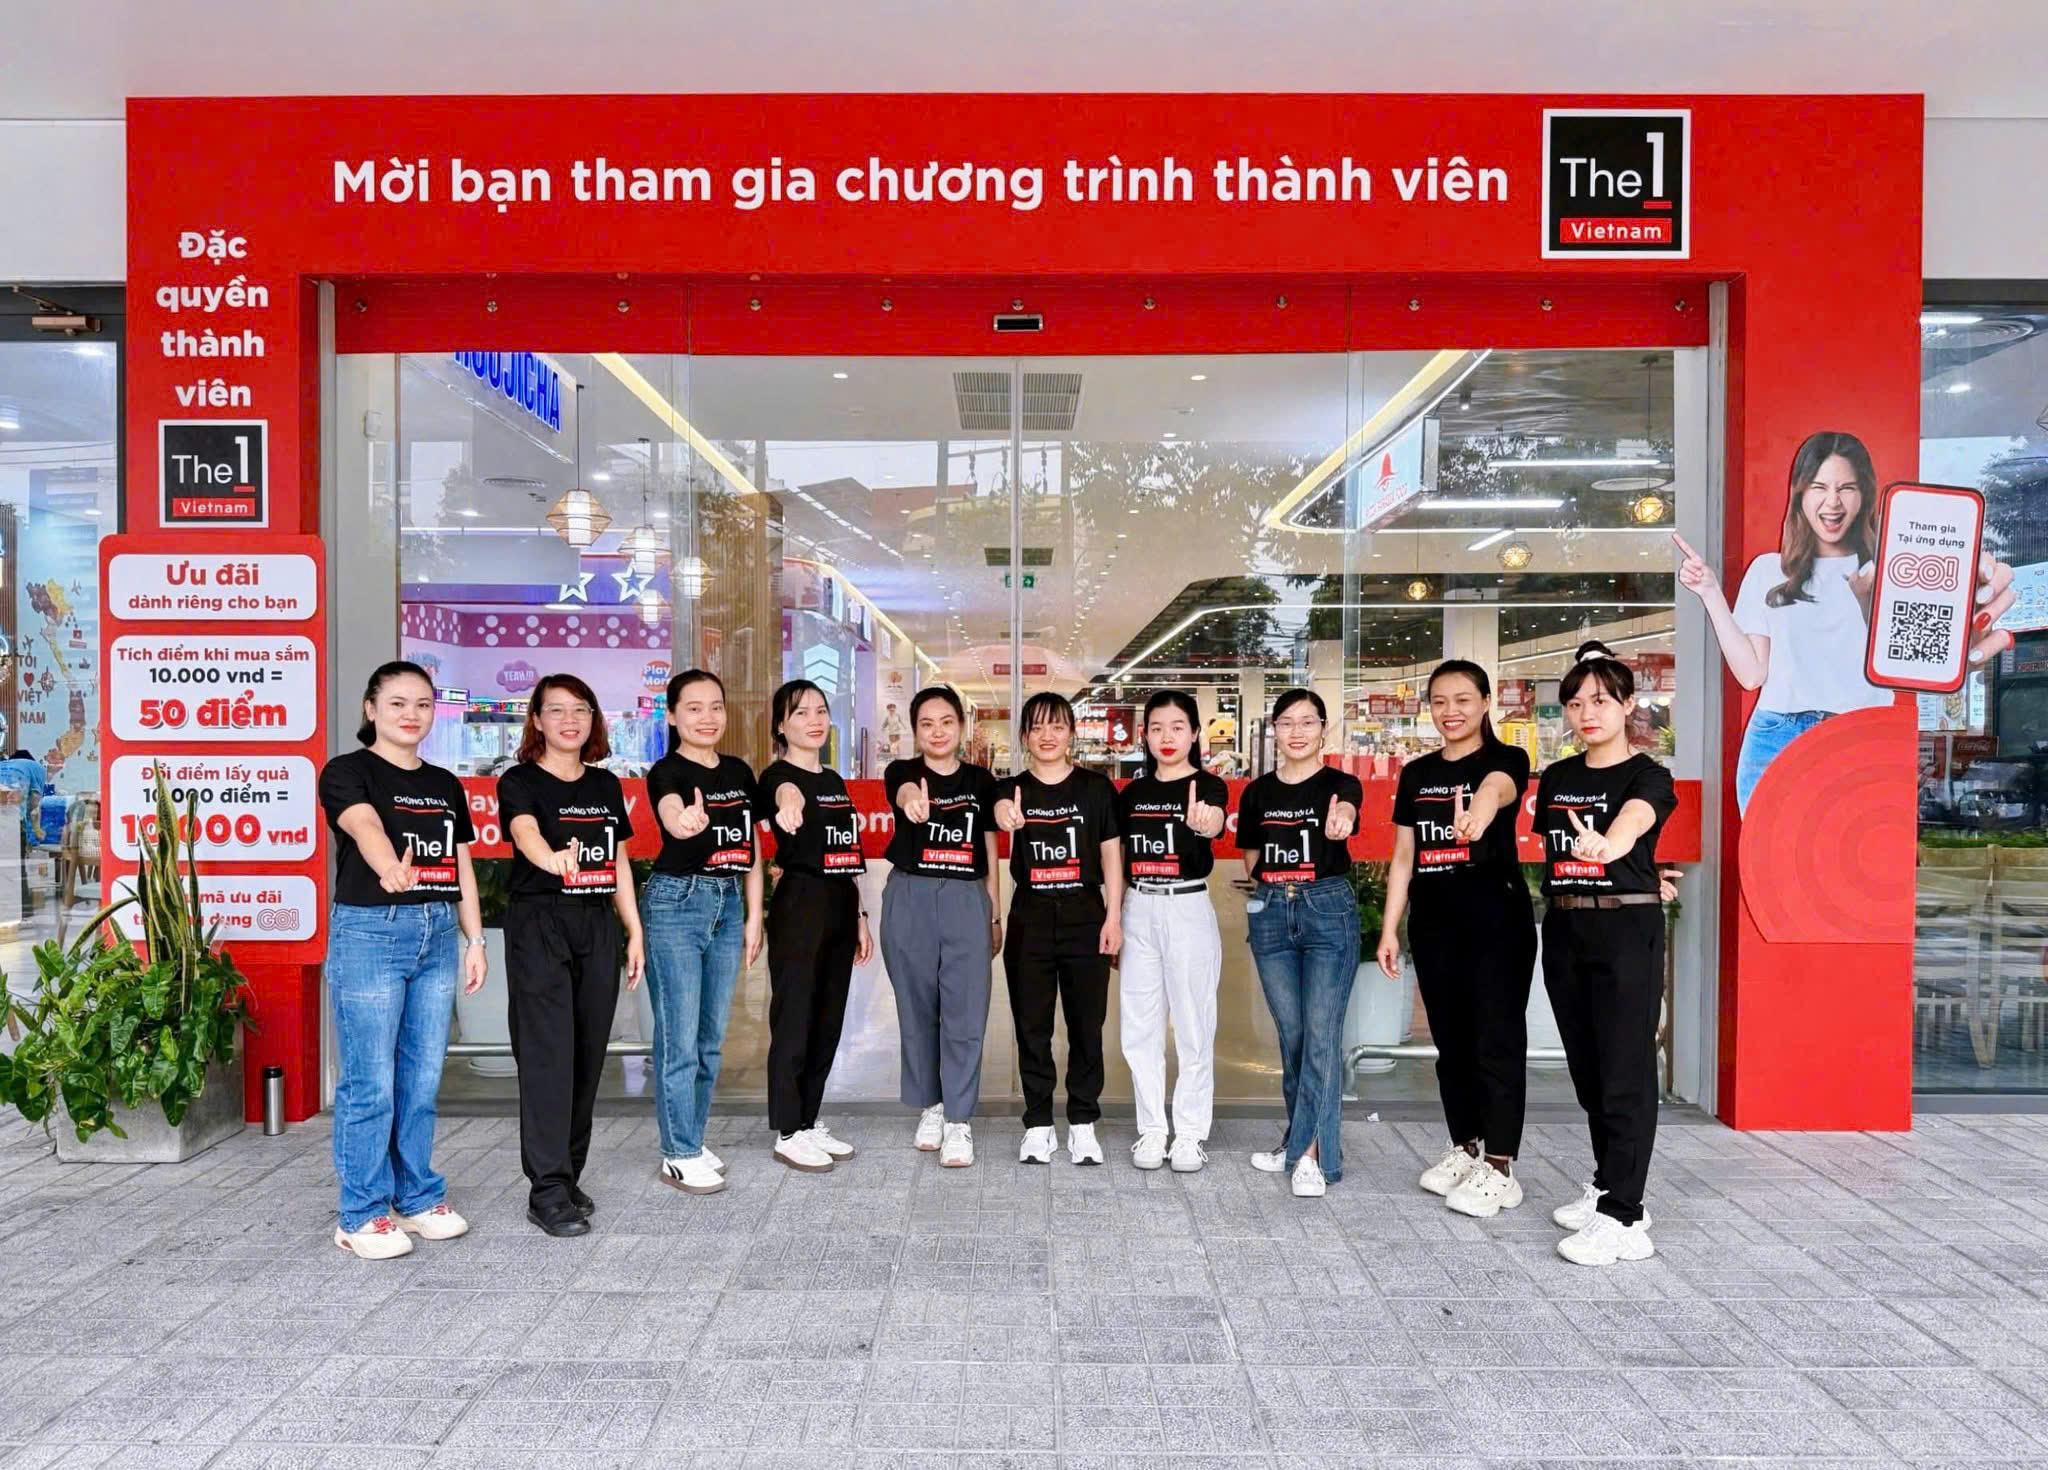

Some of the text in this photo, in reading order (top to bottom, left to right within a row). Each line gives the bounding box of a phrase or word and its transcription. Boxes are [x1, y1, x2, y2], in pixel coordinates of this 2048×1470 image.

[334, 156, 1509, 213] Mời bạn tham gia chương trình thành viên
[1571, 222, 1662, 241] Vietnam
[178, 229, 248, 266] Đặc
[156, 275, 269, 313] quyền
[160, 329, 265, 357] thành
[175, 379, 251, 407] viên
[181, 501, 248, 514] Vietnam
[1908, 520, 1956, 534] Tham gia
[1897, 533, 1965, 549] Tại ứng dụng
[166, 560, 259, 586] Ưu đãi
[1888, 552, 1959, 592] GO!
[128, 595, 297, 613] dành riêng cho bạn
[117, 643, 310, 661] Tích điểm khi mua sắm
[149, 667, 283, 684] 10.000 vnd =
[644, 665, 671, 677] Play
[643, 676, 668, 686] Mor
[20, 711, 46, 724] NAM
[138, 690, 288, 728] 50 điểm
[176, 762, 220, 780] điểm
[226, 764, 251, 782] lấy
[143, 784, 289, 804] 1000 điểm =
[1026, 808, 1055, 817] CHÚNG
[1055, 806, 1068, 816] TÔI
[1135, 802, 1182, 811] CHÚNG TÔI LÀ
[1264, 809, 1293, 819] CHÚNG
[120, 813, 308, 844] 10000 vnd
[927, 851, 970, 862] Vietnam
[1424, 851, 1465, 862] Vietnam
[1036, 871, 1076, 880] Vietnam
[1135, 863, 1175, 873] Vietnam
[199, 890, 225, 904] mã
[230, 891, 252, 904] ưu
[256, 890, 282, 904] đãi
[257, 908, 301, 931] GO!
